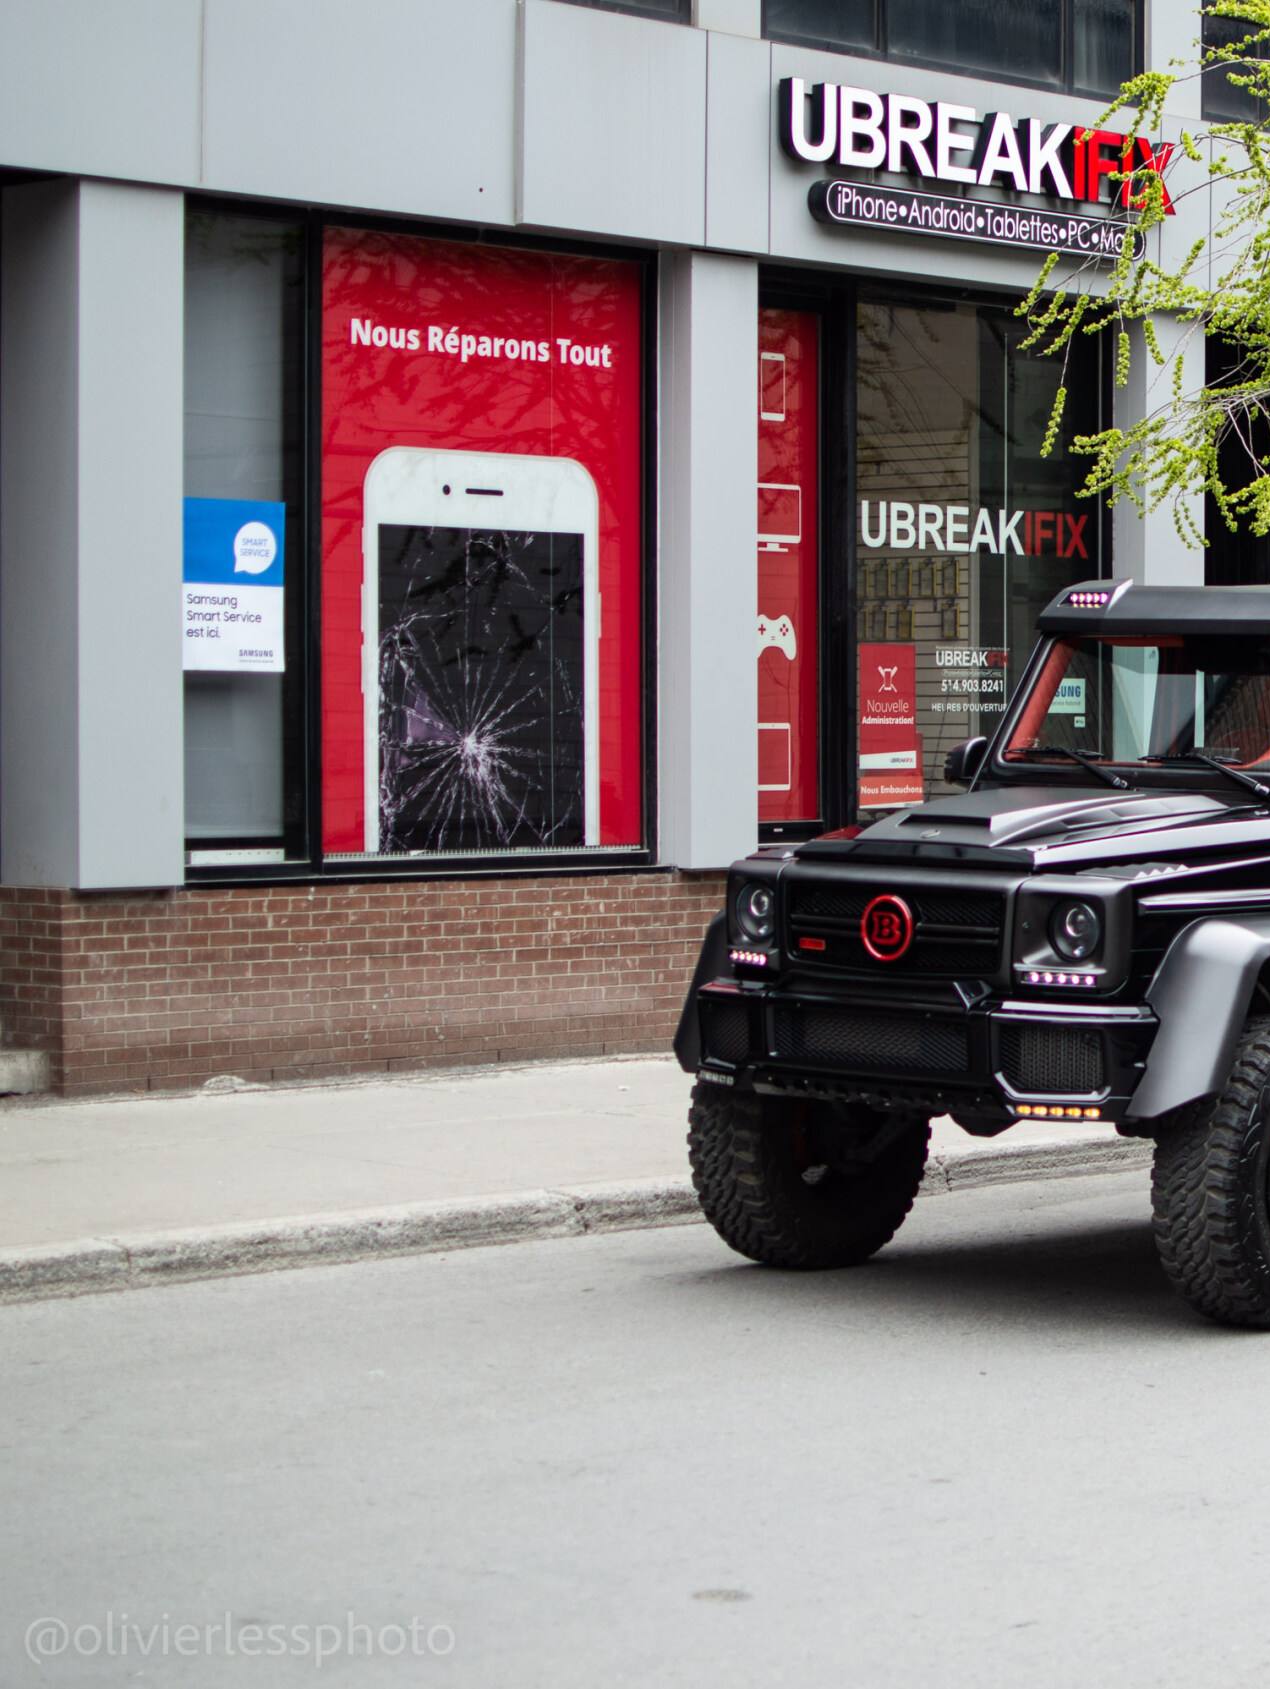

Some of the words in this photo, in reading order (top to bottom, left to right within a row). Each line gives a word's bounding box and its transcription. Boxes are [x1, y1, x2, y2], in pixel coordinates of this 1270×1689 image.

[782, 76, 1176, 216] UBREAKIFIX
[1101, 225, 1136, 254] Ma
[350, 318, 420, 350] Nous
[427, 325, 550, 363] Réparons
[556, 338, 612, 368] Tout
[861, 499, 1089, 559] UBREAKIFIX
[241, 538, 268, 547] SMART
[240, 548, 270, 558] SERVICE
[186, 593, 238, 609] Samsung
[186, 610, 221, 622] Smart
[223, 611, 262, 623] Service
[186, 627, 205, 638] est
[206, 626, 221, 639] ici.
[239, 649, 274, 658] SAMSUNG
[941, 679, 1004, 692] 514.903.8241
[867, 699, 909, 713] Nouvelle
[931, 703, 961, 712] HEURES
[861, 715, 914, 725] Administration!
[860, 785, 879, 794] Nous
